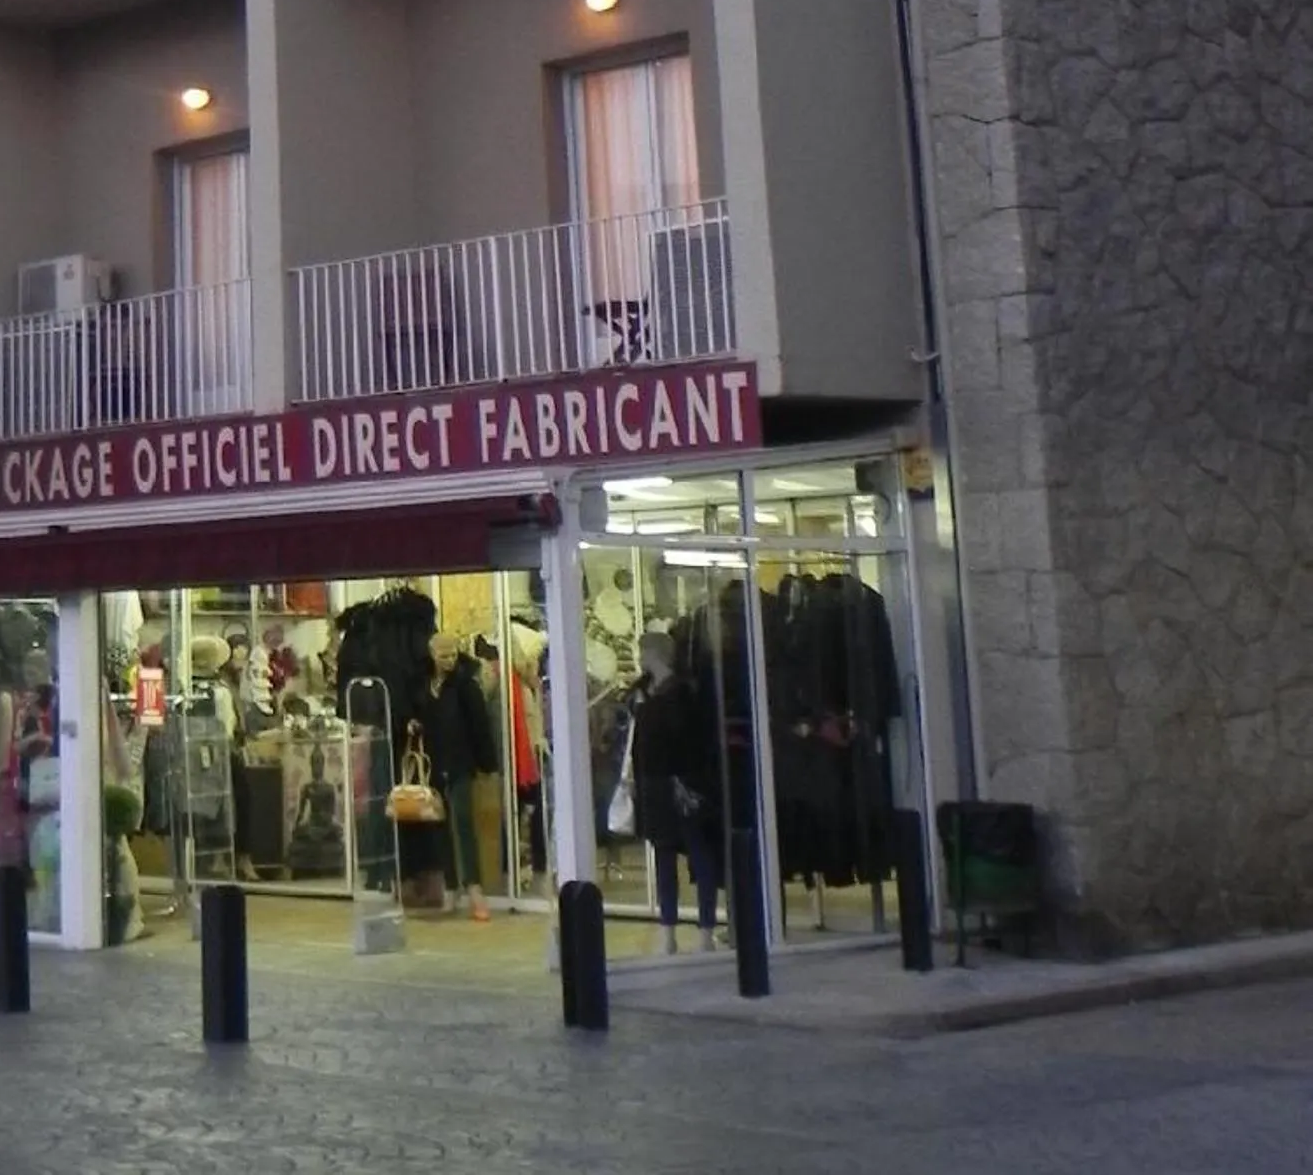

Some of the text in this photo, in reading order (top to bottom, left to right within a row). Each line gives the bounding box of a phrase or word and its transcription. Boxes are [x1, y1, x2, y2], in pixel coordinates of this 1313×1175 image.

[132, 422, 292, 495] OFFICIEL
[313, 403, 454, 480] DIRECT
[478, 370, 749, 464] FABRICANT
